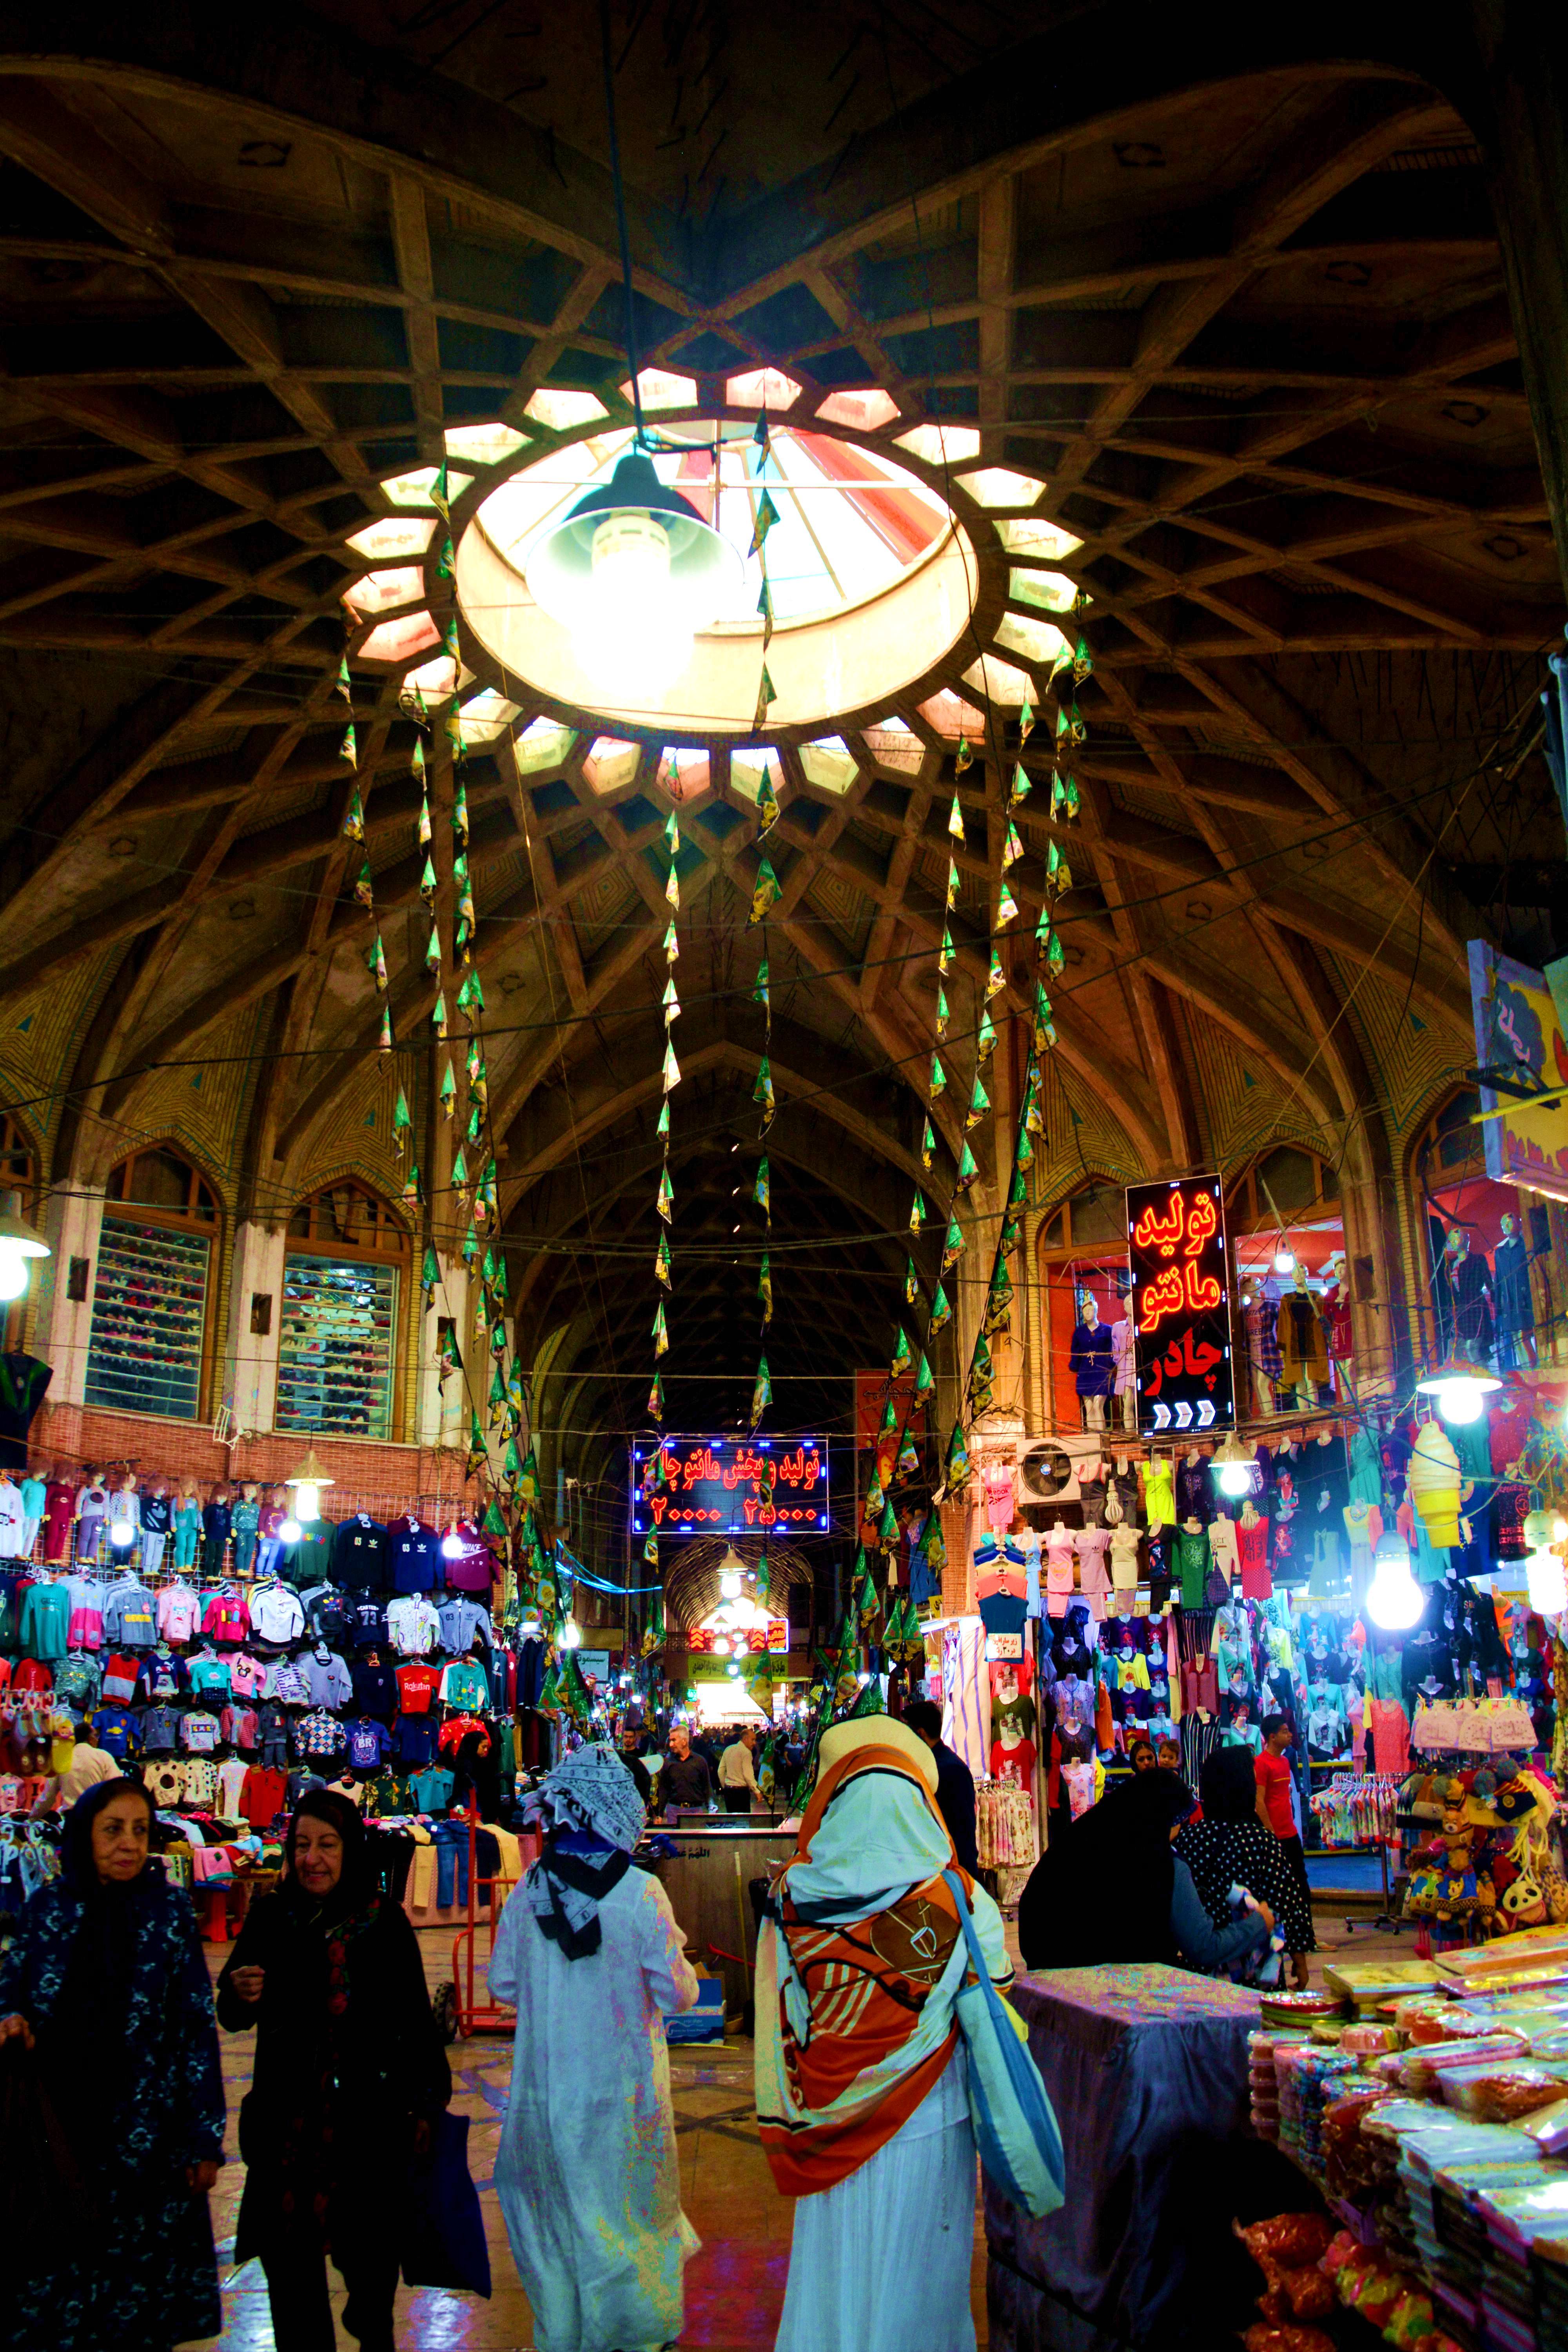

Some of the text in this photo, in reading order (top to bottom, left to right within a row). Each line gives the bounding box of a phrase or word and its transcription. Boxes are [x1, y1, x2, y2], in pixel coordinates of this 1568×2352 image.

[1134, 1191, 1217, 1257] تولید
[1140, 1259, 1221, 1332] مانتو
[1144, 1326, 1222, 1396] چادر
[682, 1448, 720, 1490] مانتو
[722, 1448, 764, 1493] پخش
[779, 1447, 819, 1490] تولید
[650, 1497, 722, 1525] ۲۰۰۰۰
[354, 1537, 362, 1546] 03
[402, 1543, 410, 1552] 03
[462, 1543, 481, 1553] NIKE
[360, 1611, 377, 1626] 73
[404, 1682, 430, 1691] Rakuten
[358, 1737, 372, 1748] BR
